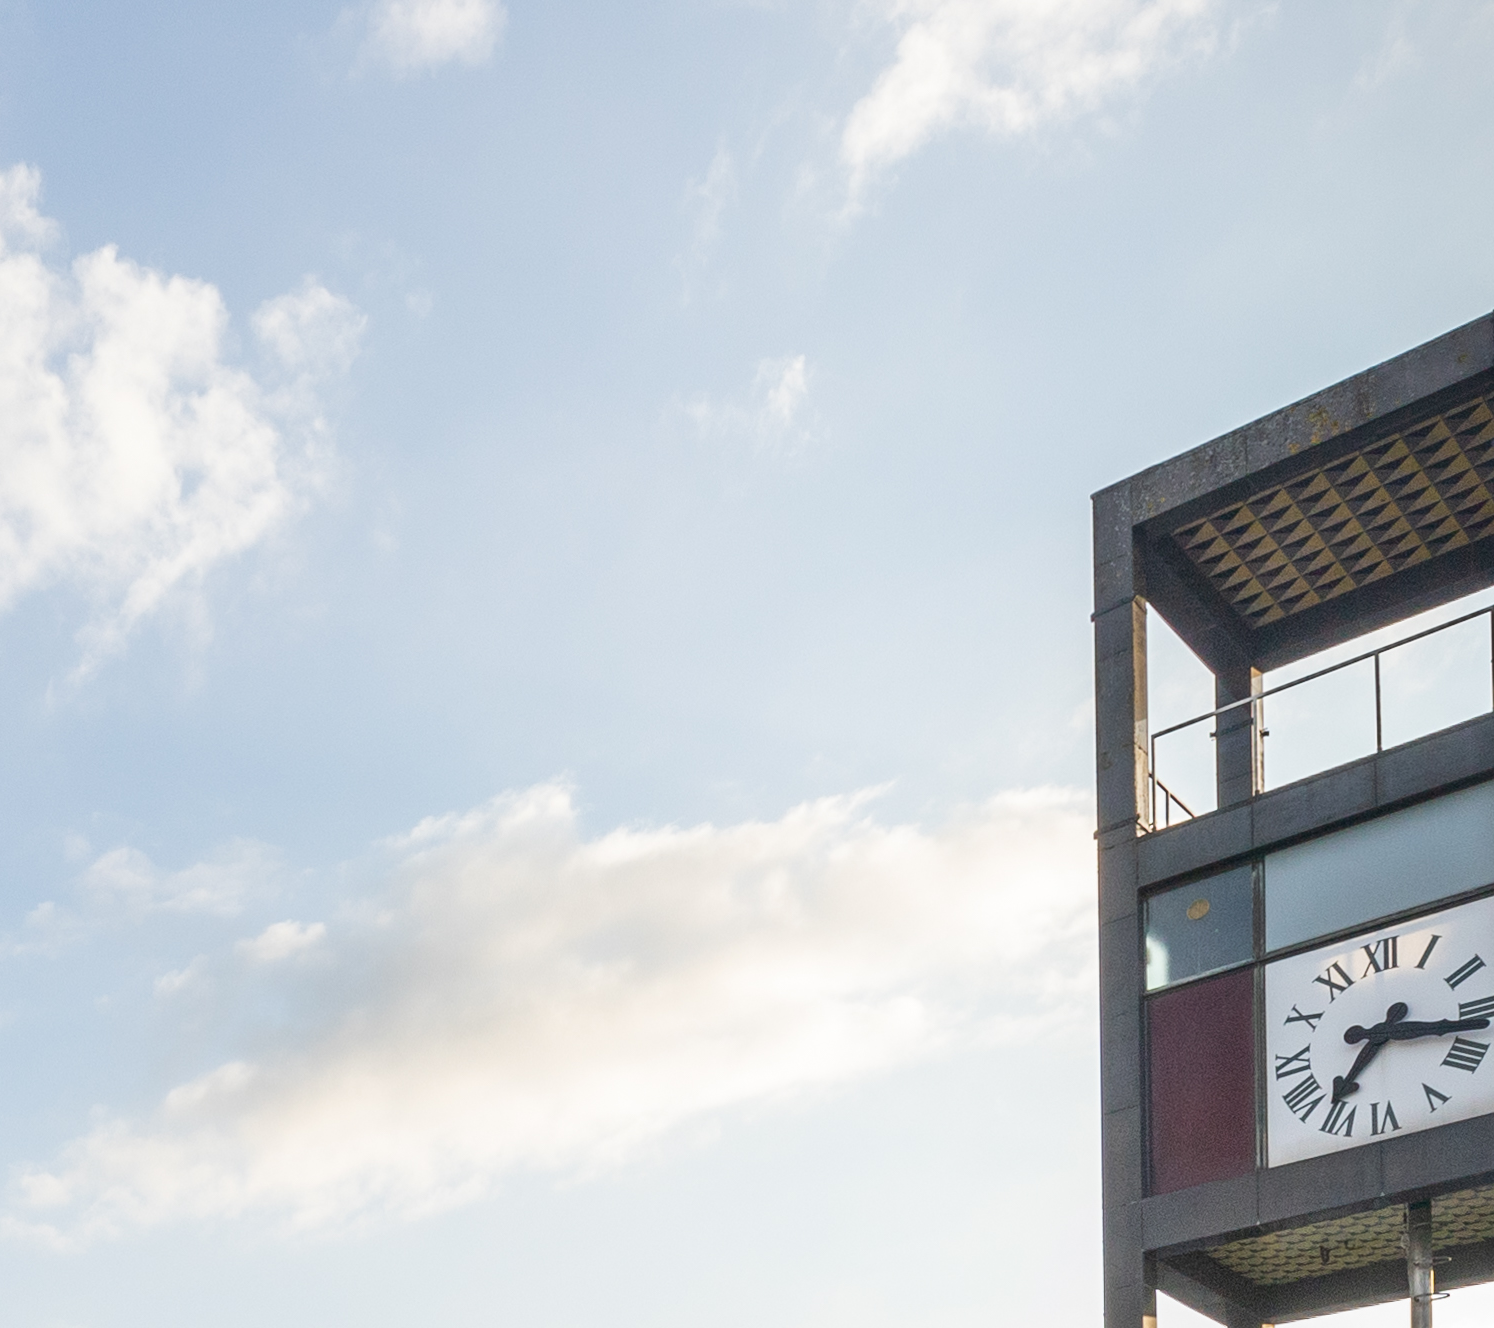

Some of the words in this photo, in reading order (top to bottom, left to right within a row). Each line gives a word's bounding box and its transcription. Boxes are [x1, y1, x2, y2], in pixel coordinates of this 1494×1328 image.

[1360, 935, 1400, 979] XII
[1312, 961, 1357, 1004] XI
[1283, 1004, 1325, 1032] X
[1275, 1043, 1312, 1081] IX
[1422, 1083, 1452, 1113] V
